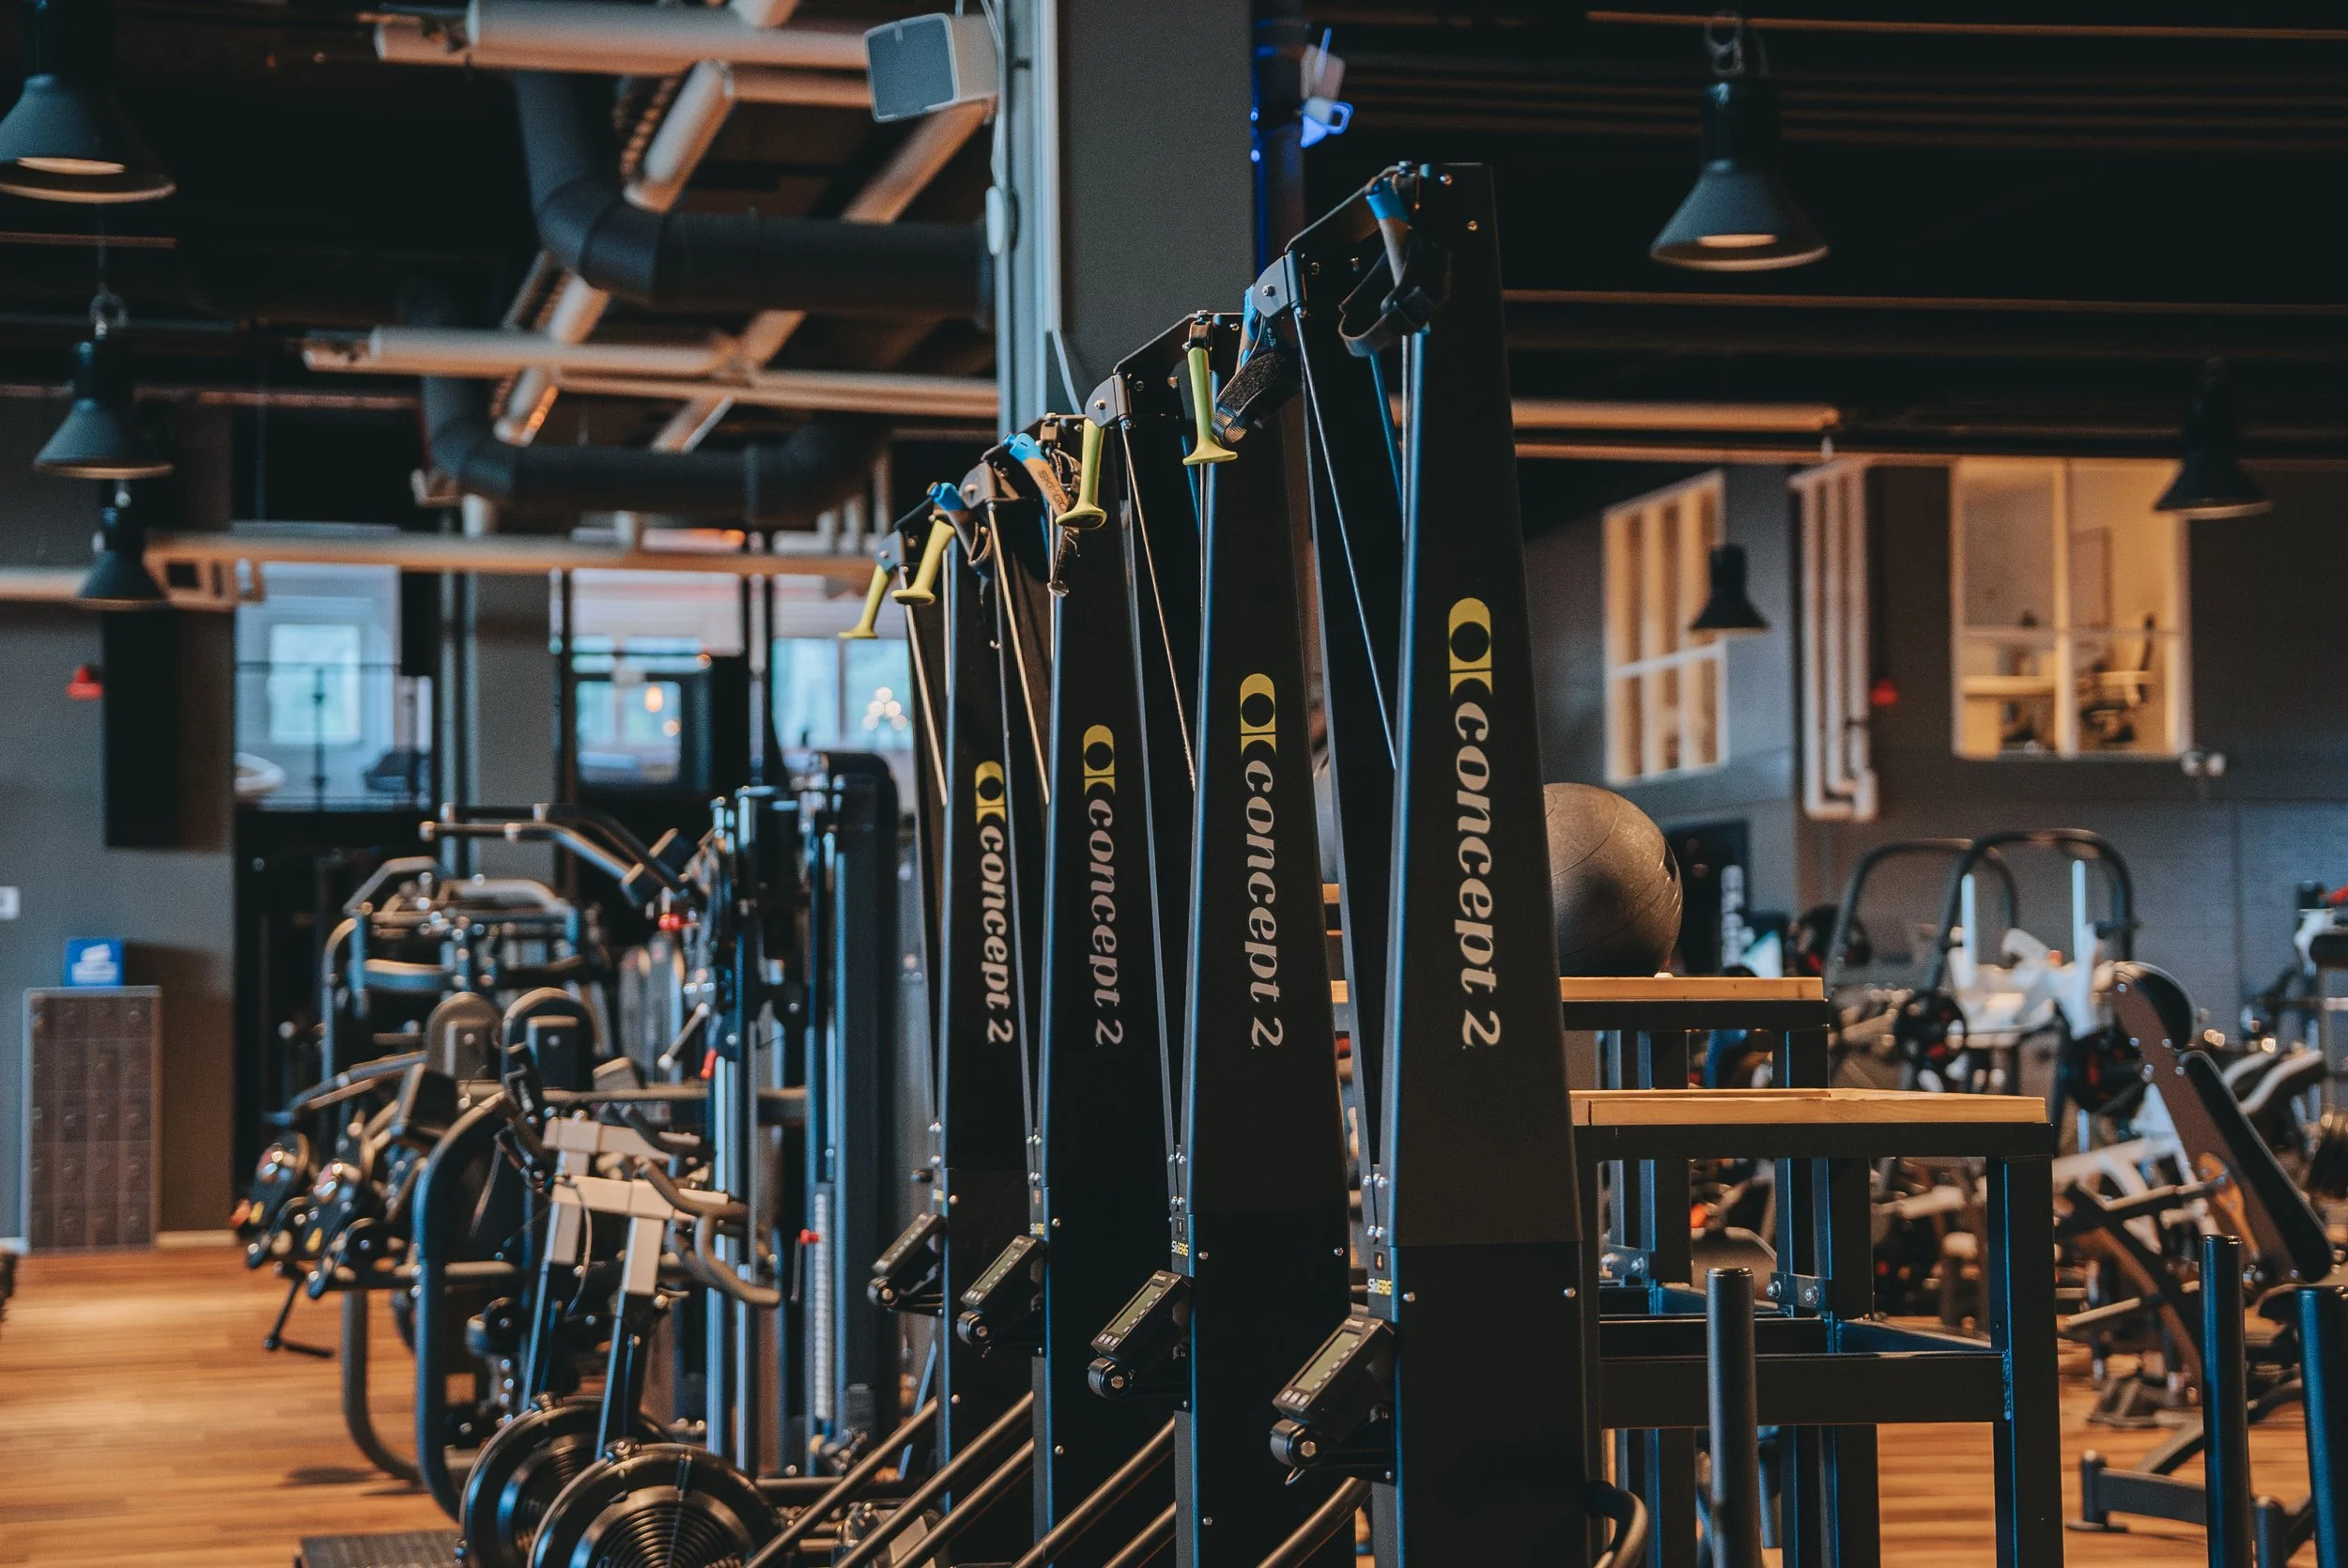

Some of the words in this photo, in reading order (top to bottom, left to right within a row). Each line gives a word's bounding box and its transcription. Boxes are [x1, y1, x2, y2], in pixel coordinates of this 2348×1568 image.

[1244, 760, 1280, 1004] concept
[1454, 701, 1497, 994] concept
[980, 825, 1011, 1009] concept
[1088, 798, 1120, 1008] concept
[986, 1018, 1014, 1044] 2
[1095, 1019, 1124, 1045] 2
[1251, 1016, 1284, 1047] 2
[1461, 1009, 1501, 1046] 2
